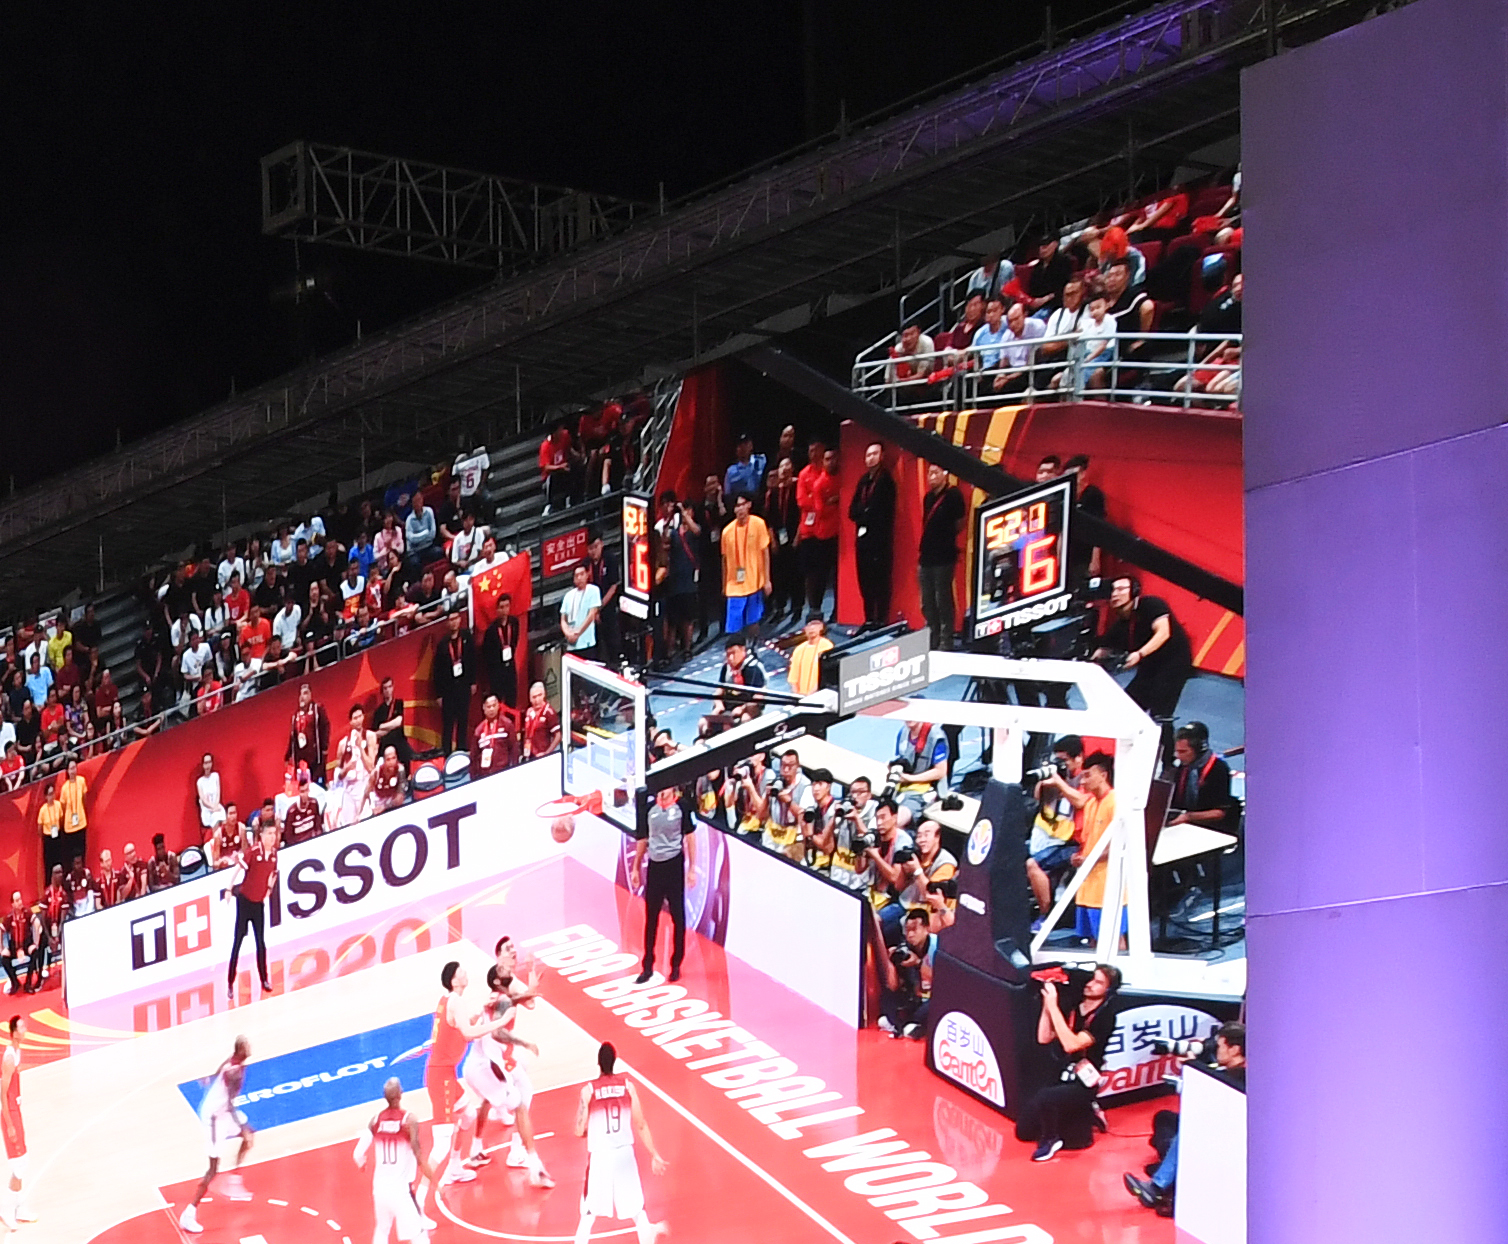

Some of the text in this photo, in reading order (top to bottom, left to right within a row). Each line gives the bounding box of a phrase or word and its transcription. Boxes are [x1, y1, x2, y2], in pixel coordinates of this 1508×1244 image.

[546, 532, 586, 556] 安全出口
[1022, 535, 1057, 595] 6
[1003, 593, 1072, 629] TISSOT
[844, 654, 925, 698] TISSOT
[220, 802, 477, 928] ISSOT
[520, 923, 639, 984] FIBA
[582, 971, 866, 1140] BASKETBALL
[946, 1018, 985, 1058] 百岁山
[232, 1056, 388, 1107] EROFLOT
[604, 1105, 621, 1134] 19
[382, 1137, 398, 1165] 10
